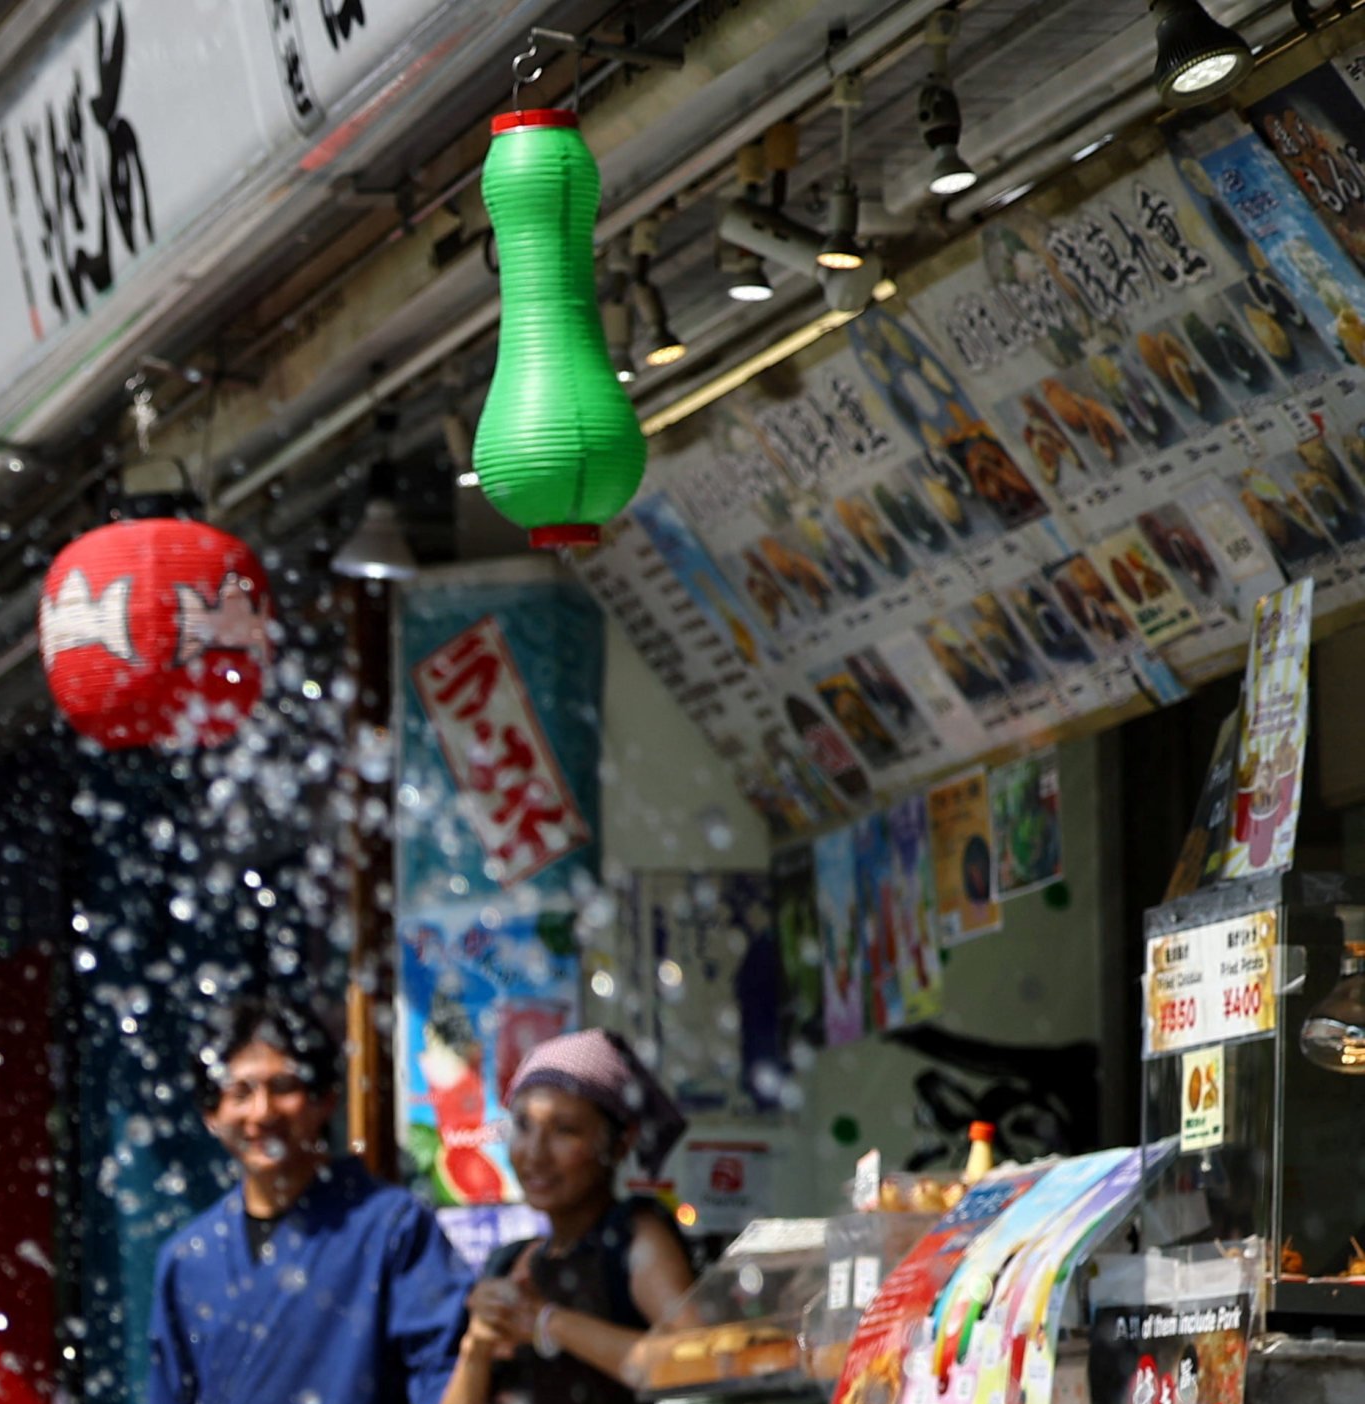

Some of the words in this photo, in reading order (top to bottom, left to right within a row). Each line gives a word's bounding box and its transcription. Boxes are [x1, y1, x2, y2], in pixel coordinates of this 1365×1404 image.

[1160, 997, 1196, 1032] ¥350
[1224, 983, 1261, 1021] ¥400
[1178, 1309, 1217, 1335] include
[1217, 1305, 1242, 1331] Pork
